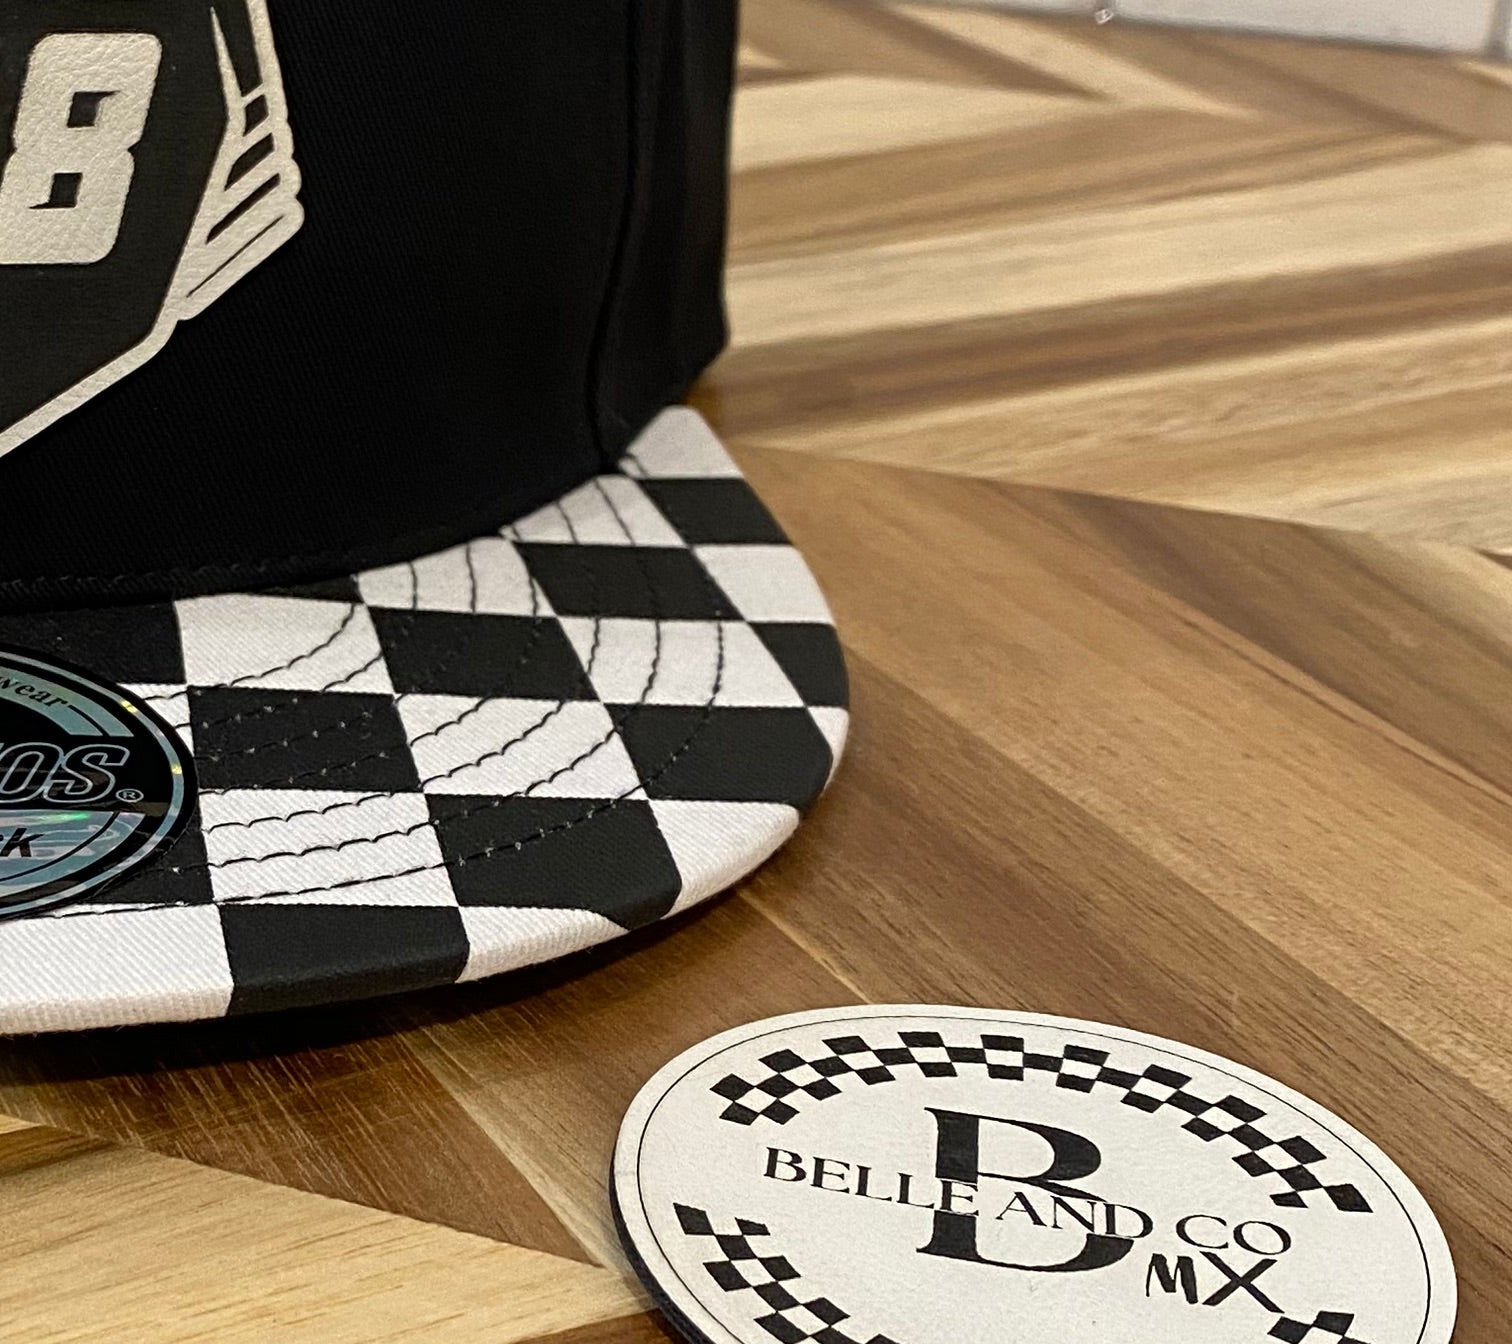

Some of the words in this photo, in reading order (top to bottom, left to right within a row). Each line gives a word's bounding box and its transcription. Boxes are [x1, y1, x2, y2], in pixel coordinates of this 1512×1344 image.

[763, 1146, 979, 1217] BELLE
[995, 1191, 1154, 1240] AND
[1175, 1213, 1292, 1255] CO
[916, 1106, 1134, 1273] B
[1145, 1252, 1285, 1314] MX
